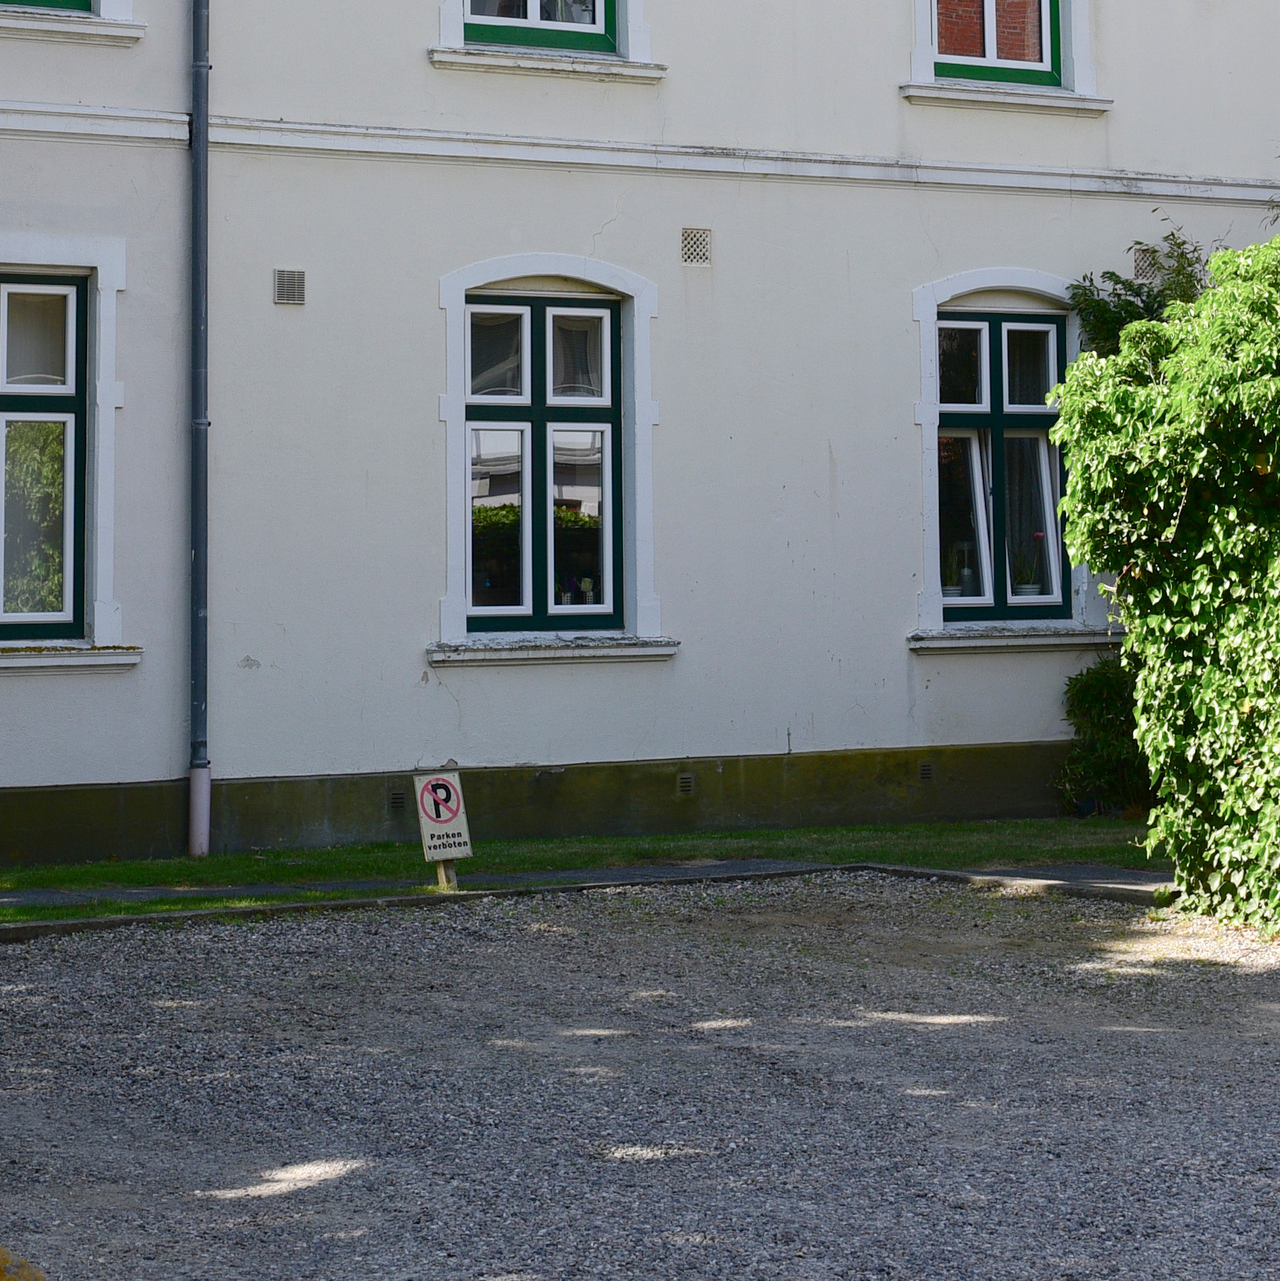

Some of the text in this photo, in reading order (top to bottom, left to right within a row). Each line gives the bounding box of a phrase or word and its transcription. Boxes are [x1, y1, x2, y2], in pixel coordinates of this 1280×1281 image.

[431, 783, 451, 818] P
[430, 832, 462, 840] Parken
[428, 840, 468, 850] verboten
